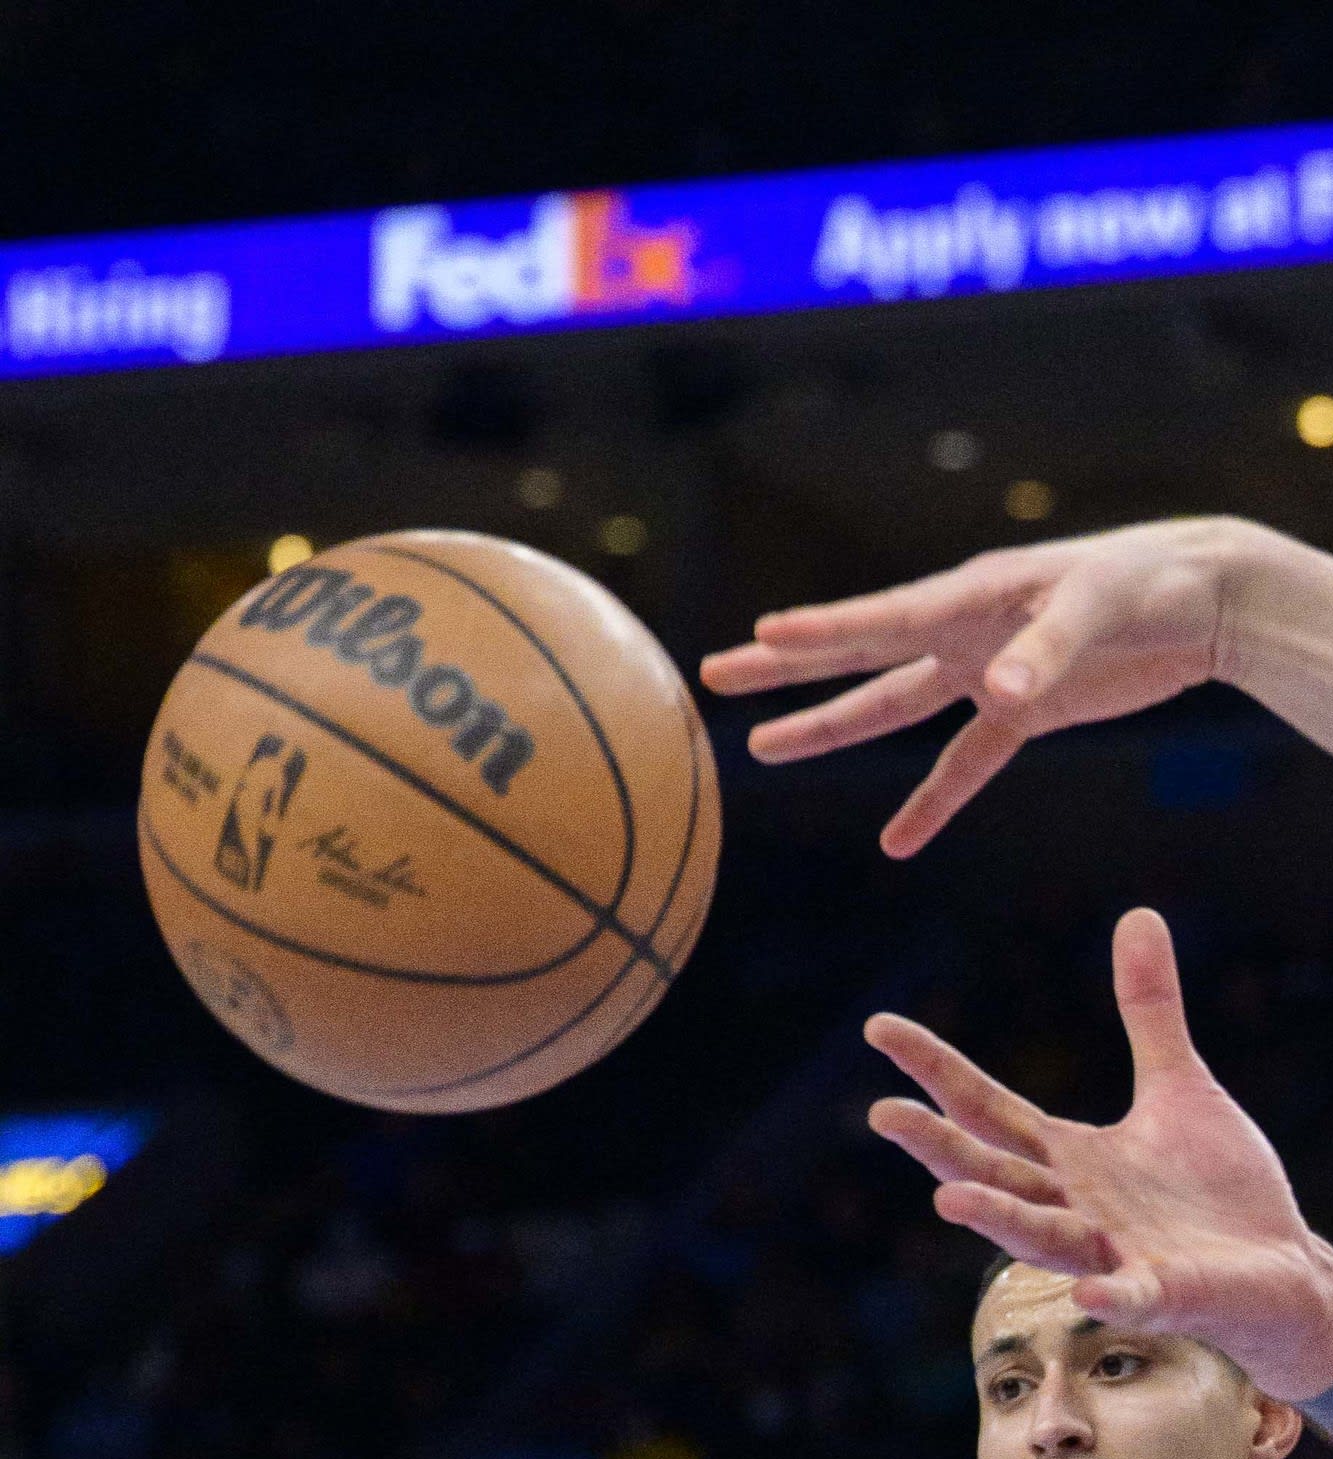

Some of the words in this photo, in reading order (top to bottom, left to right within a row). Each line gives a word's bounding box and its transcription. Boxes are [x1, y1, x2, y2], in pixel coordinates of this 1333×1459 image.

[370, 190, 698, 331] FedEx
[813, 182, 1028, 302] Apply
[1035, 184, 1200, 268] now
[240, 566, 537, 796] Wilson
